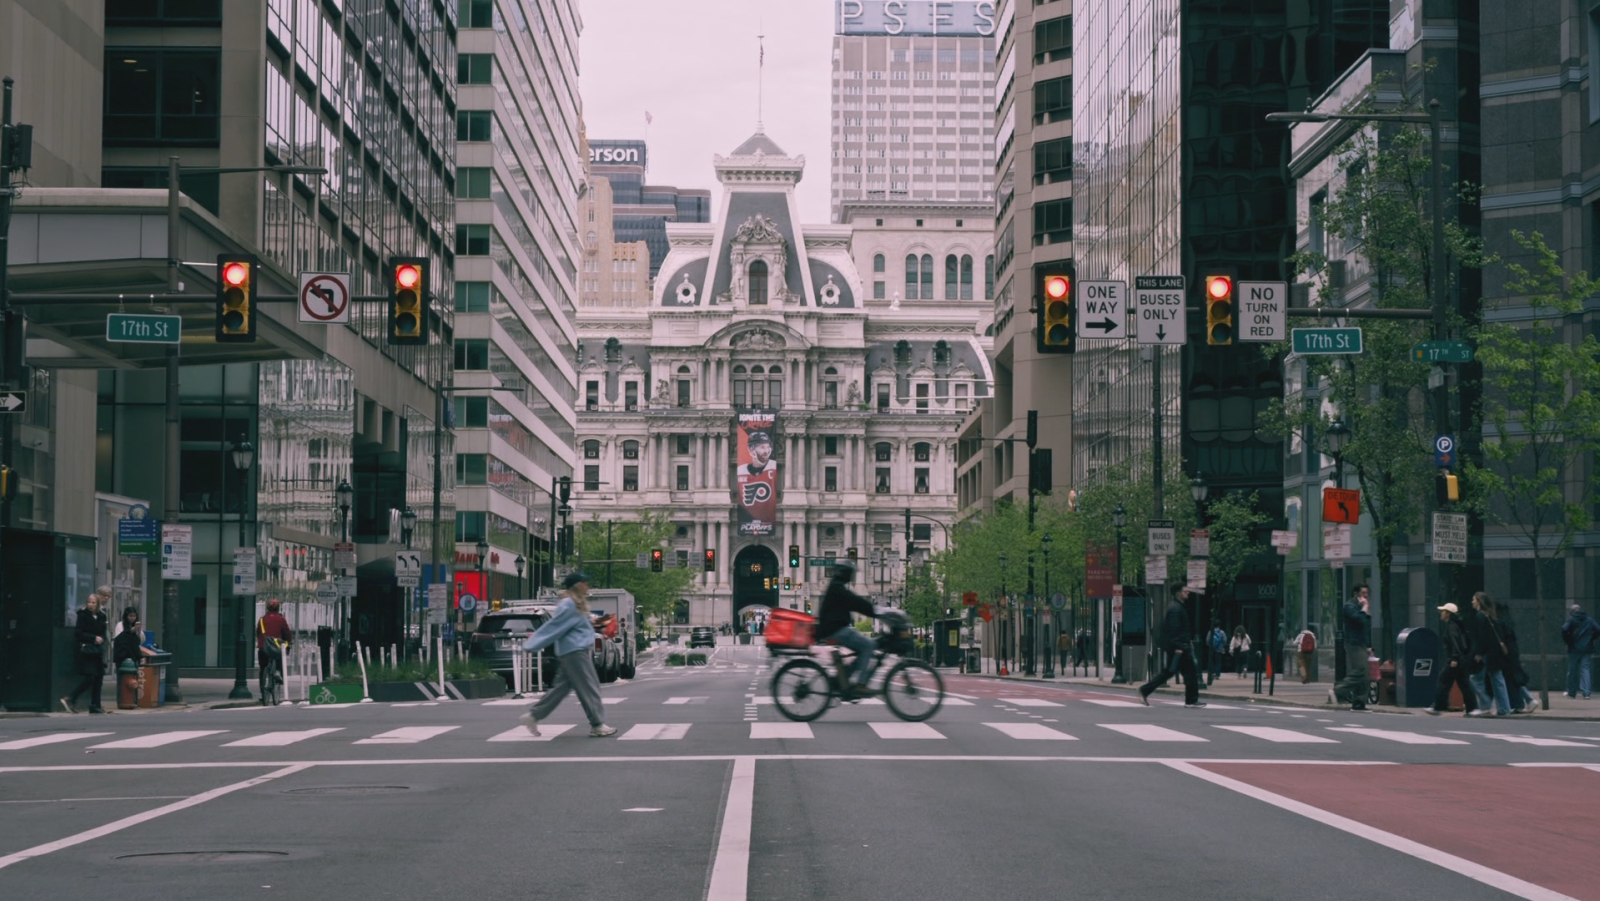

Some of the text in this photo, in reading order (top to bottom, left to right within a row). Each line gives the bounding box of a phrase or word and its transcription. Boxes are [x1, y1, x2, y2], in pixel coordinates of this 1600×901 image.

[1138, 278, 1182, 287] THIS LANE
[1087, 286, 1117, 299] ONE
[1251, 287, 1274, 300] NO
[1140, 294, 1181, 305] BUSES
[1086, 302, 1118, 314] WAY
[1246, 303, 1278, 313] TURN
[1143, 309, 1177, 320] ONLY
[1254, 314, 1270, 324] ON
[121, 320, 168, 337] 17th St
[1250, 327, 1274, 336] RED
[1304, 334, 1350, 349] 17th St
[1429, 349, 1440, 360] 17
[1461, 350, 1469, 359] ST
[1328, 492, 1357, 502] DETOUR
[1258, 584, 1276, 595] 1600
